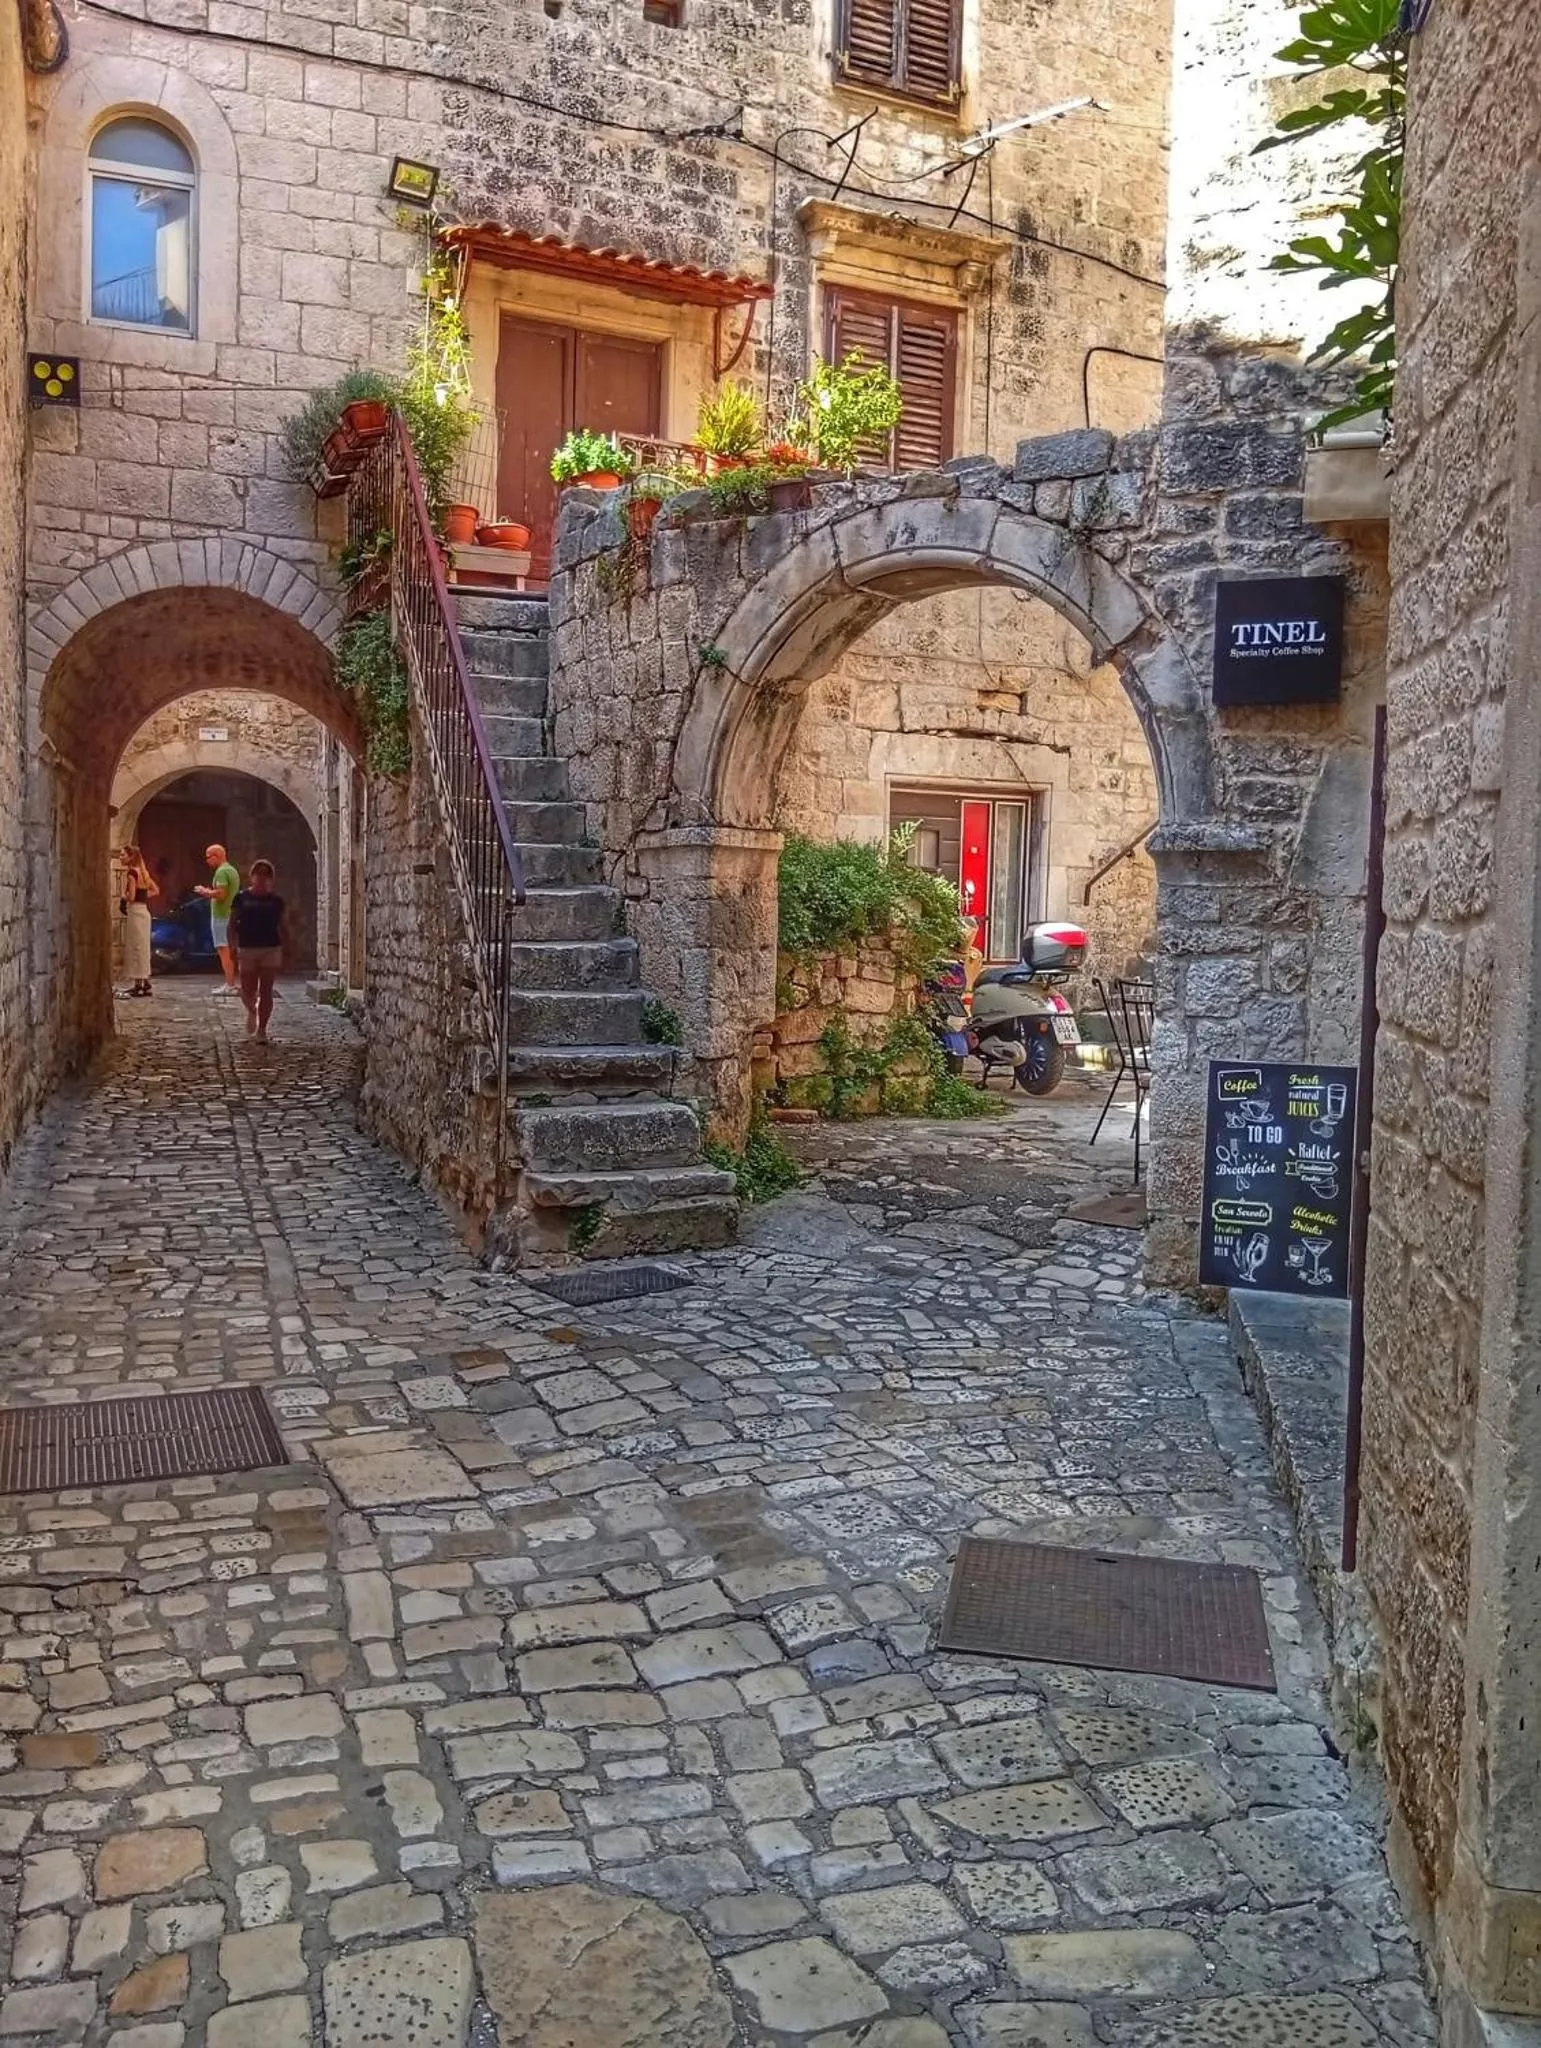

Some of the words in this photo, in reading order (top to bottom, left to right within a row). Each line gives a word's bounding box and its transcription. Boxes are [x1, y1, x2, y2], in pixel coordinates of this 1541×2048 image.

[1231, 621, 1326, 646] TINEL
[1230, 648, 1270, 659] Specialty
[1271, 646, 1300, 656] Coffee
[1301, 645, 1325, 656] Shop
[1223, 1079, 1257, 1092] Coffee
[1288, 1074, 1320, 1085] Fresh
[1288, 1090, 1320, 1100] natural
[1287, 1101, 1319, 1117] JUICES
[1247, 1125, 1262, 1143] TO
[1266, 1125, 1282, 1144] GO
[1215, 1163, 1276, 1177] Breakfast
[1217, 1205, 1234, 1216] San
[1293, 1206, 1338, 1226] Alcoholic
[1289, 1219, 1322, 1236] Drinks
